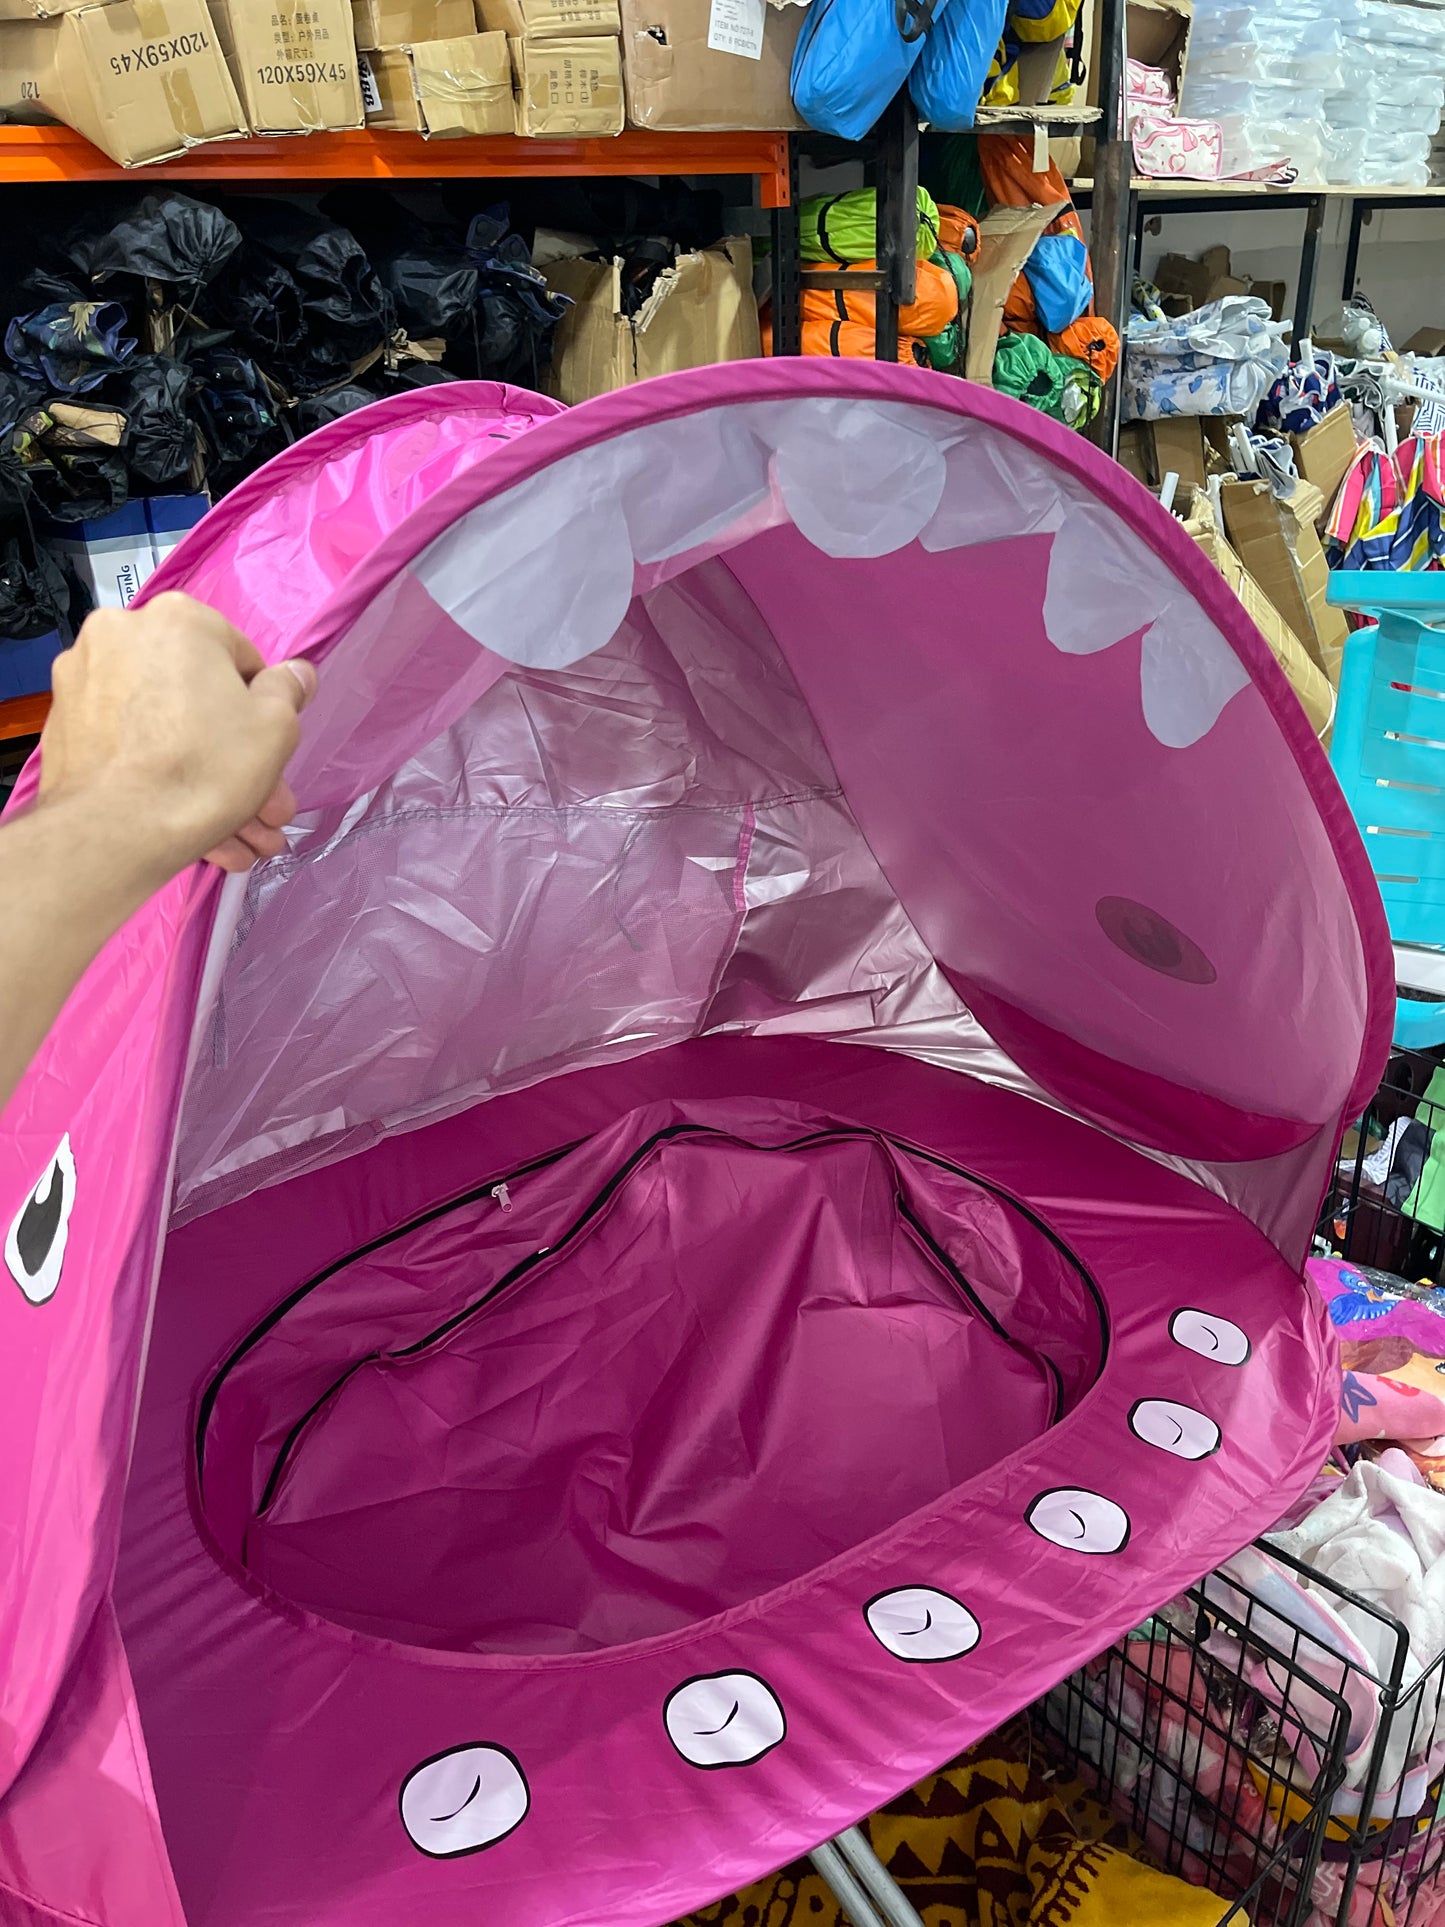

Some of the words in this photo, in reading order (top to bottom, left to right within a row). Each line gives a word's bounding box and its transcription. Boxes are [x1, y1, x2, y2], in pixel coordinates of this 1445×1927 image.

[110, 31, 209, 75] 120X59X45
[257, 62, 346, 85] 120X59X45
[21, 81, 41, 99] 120
